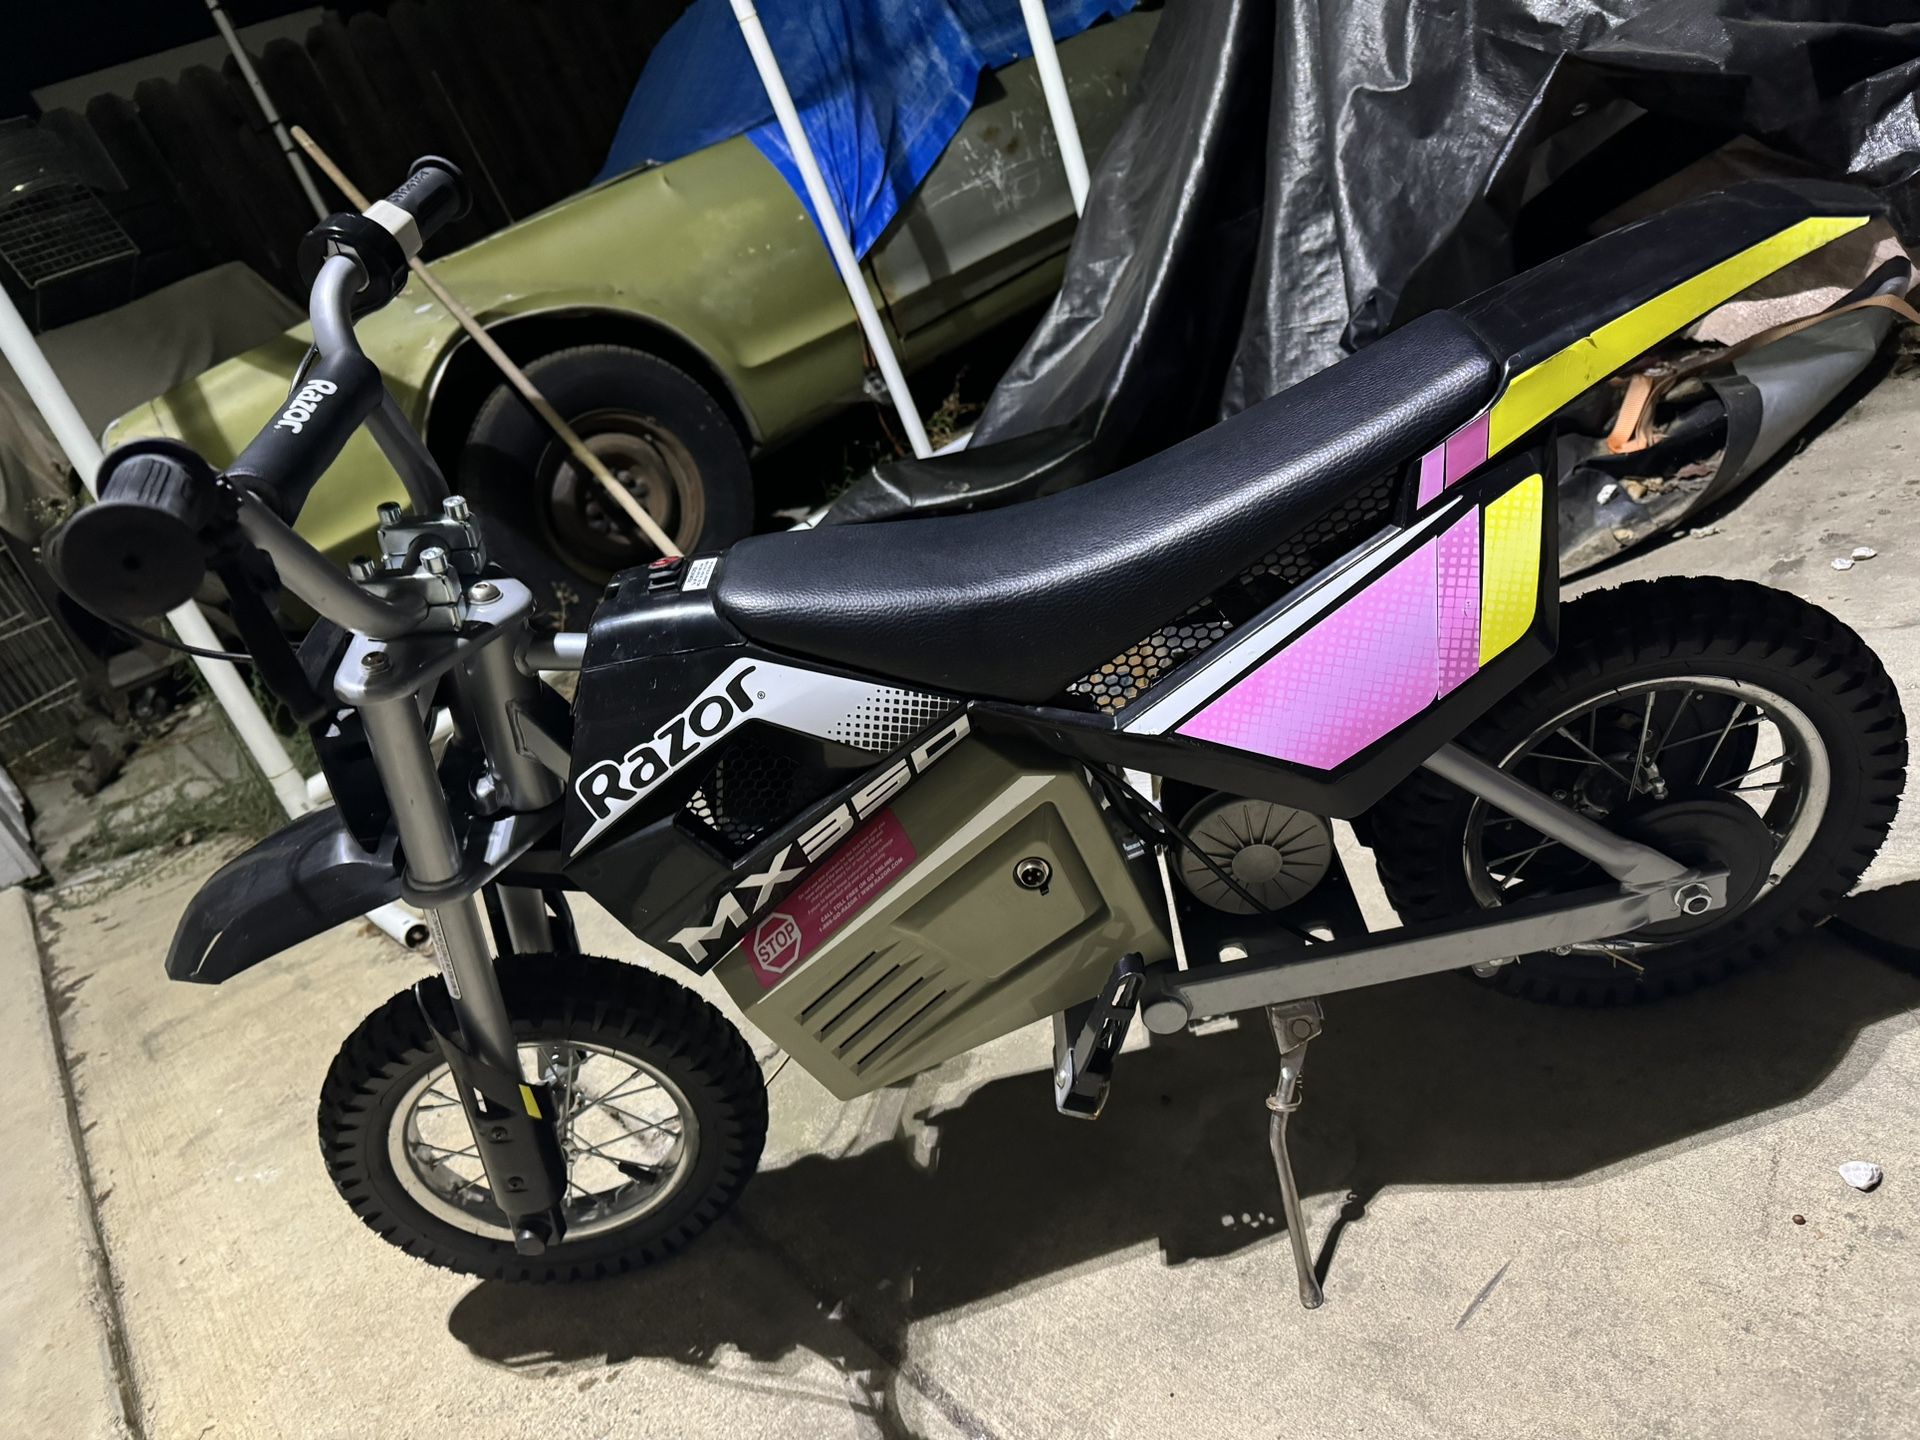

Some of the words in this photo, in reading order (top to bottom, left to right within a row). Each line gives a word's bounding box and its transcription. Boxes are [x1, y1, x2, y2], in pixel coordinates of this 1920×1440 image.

[277, 379, 338, 434] Razor
[579, 665, 757, 820] Razor
[667, 713, 971, 965] MX350
[758, 921, 796, 963] STOP
